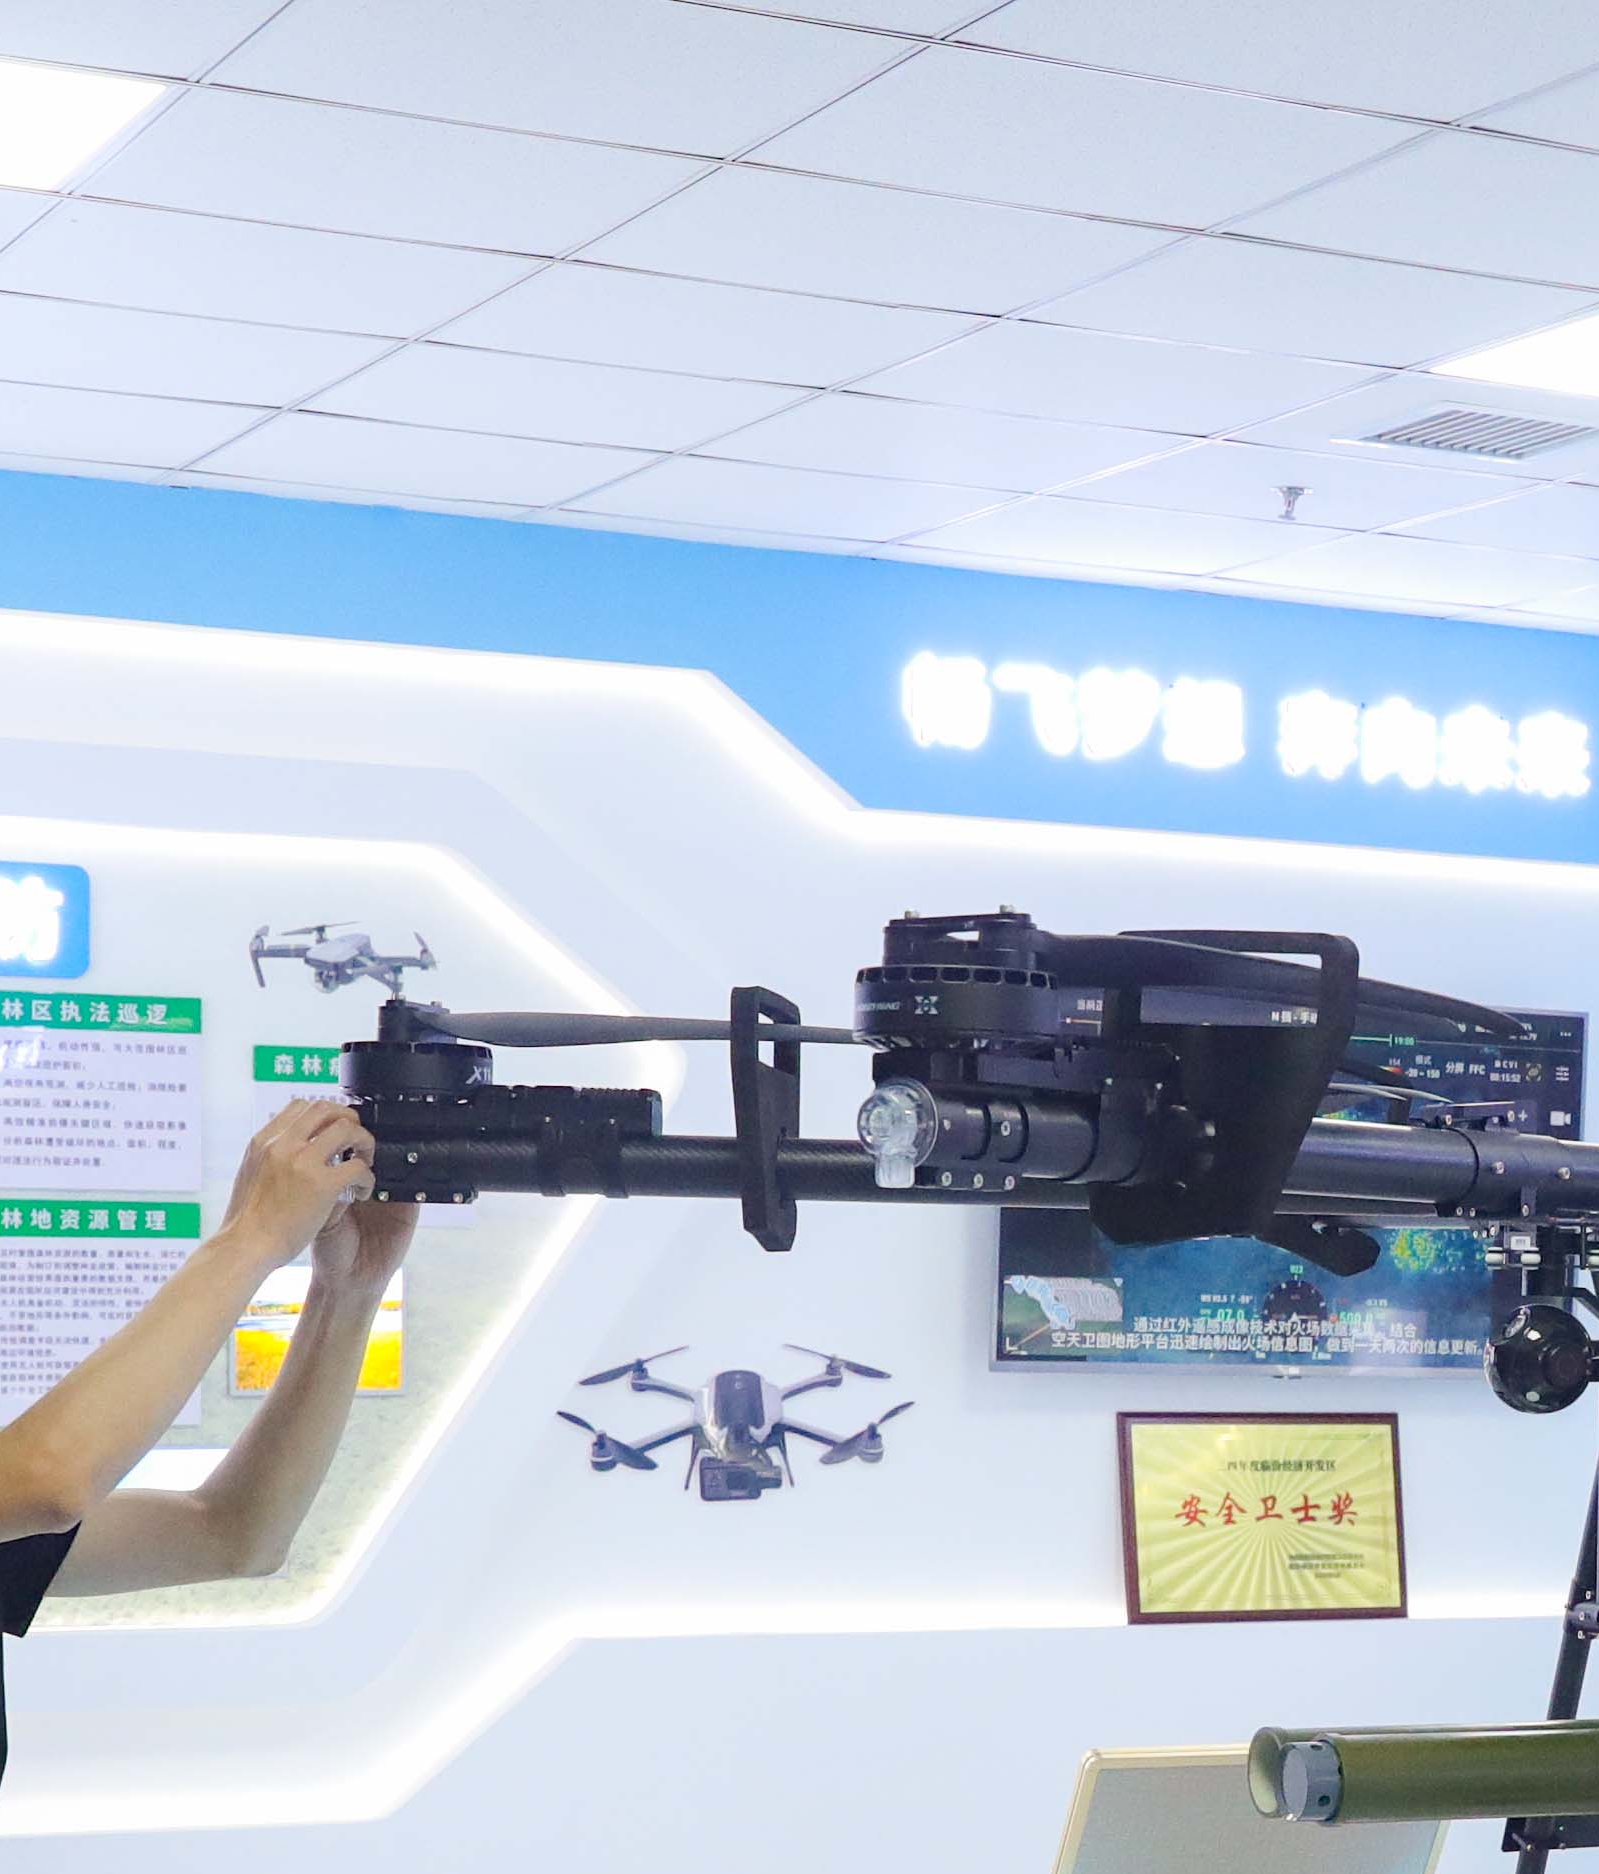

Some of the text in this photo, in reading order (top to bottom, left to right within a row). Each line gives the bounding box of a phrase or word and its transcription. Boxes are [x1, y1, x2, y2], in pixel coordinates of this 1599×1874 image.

[2, 998, 169, 1026] 林区执法巡逻
[1, 1207, 167, 1231] 林地资源管理
[1175, 1491, 1358, 1527] 安全卫士奖
